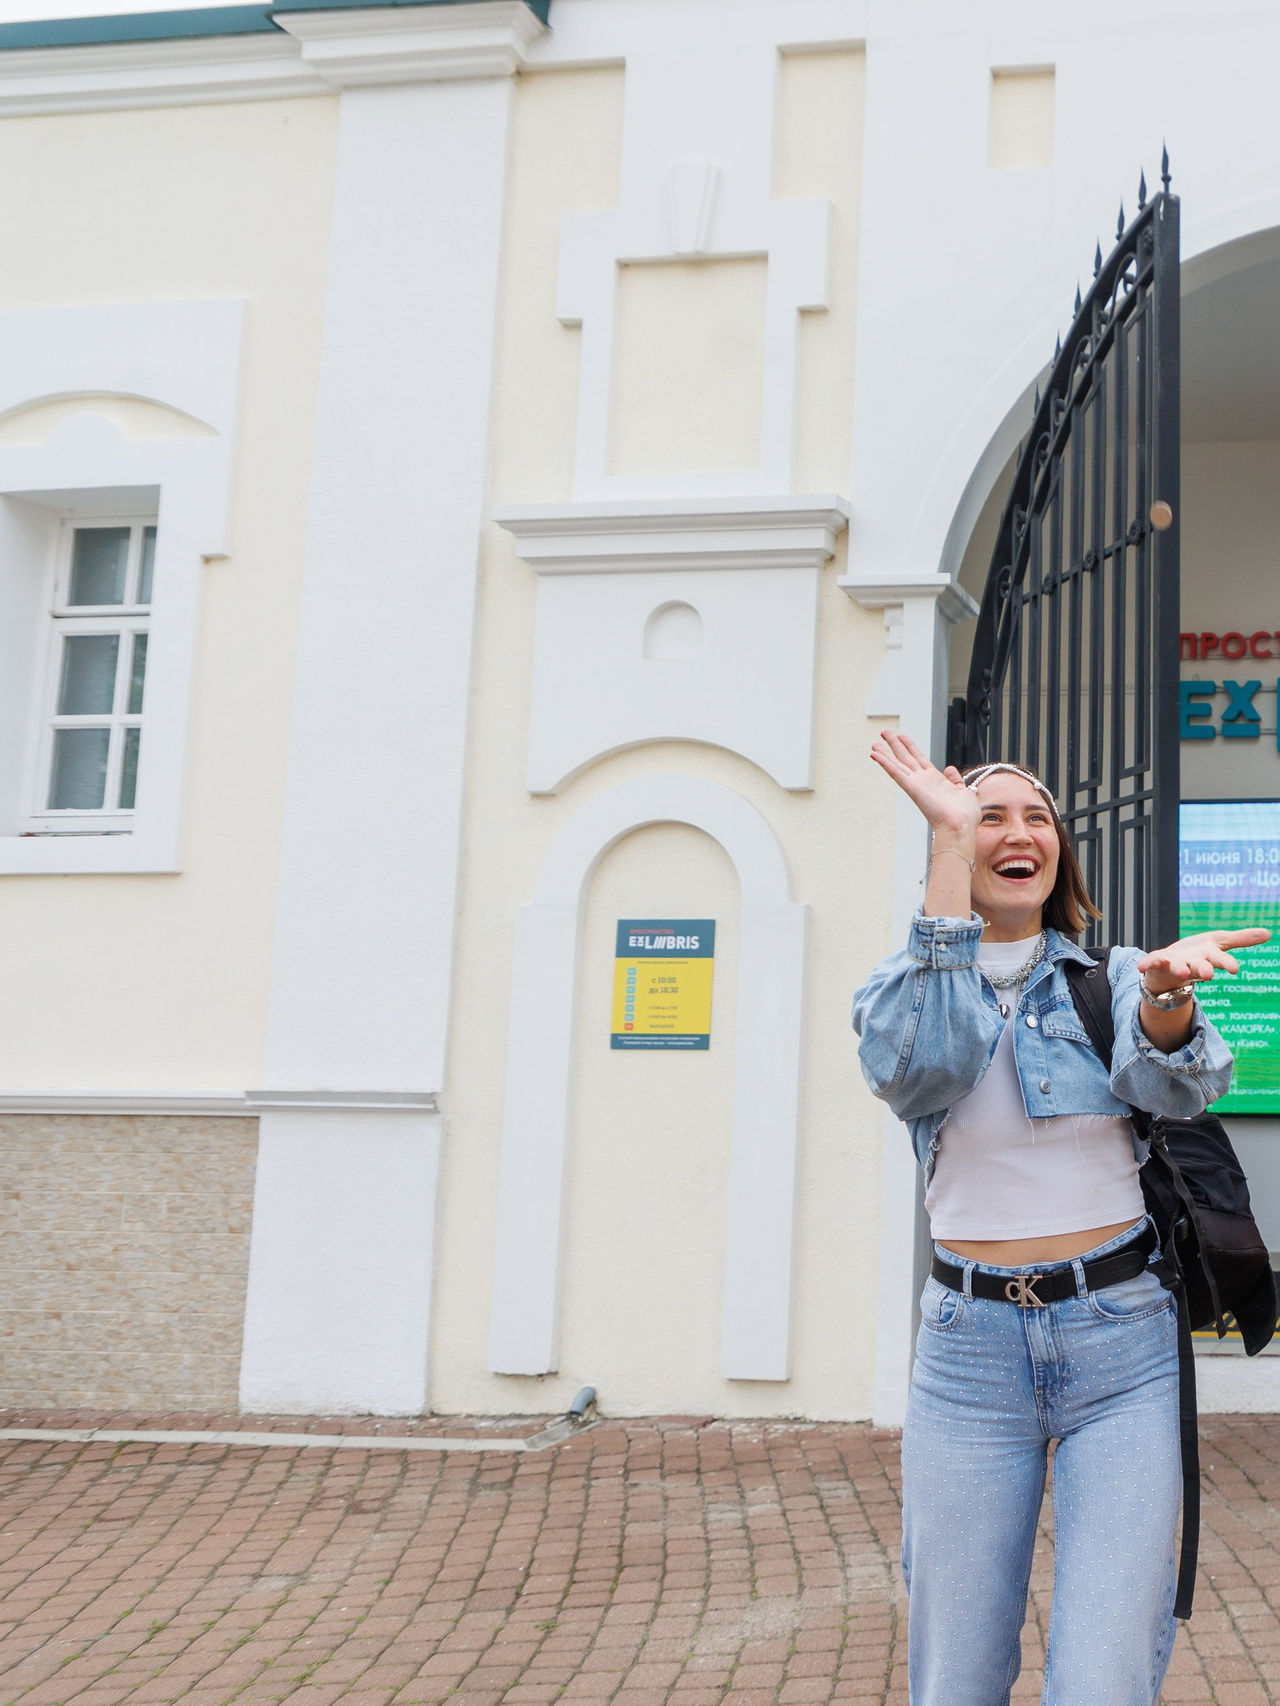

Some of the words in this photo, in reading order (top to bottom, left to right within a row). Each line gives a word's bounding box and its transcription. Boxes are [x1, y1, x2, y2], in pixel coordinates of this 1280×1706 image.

[1180, 848, 1190, 864] 1
[1195, 851, 1241, 865] июня
[1180, 870, 1245, 889] онцерт
[658, 976, 677, 984] 10:00
[660, 986, 679, 994] 18:30
